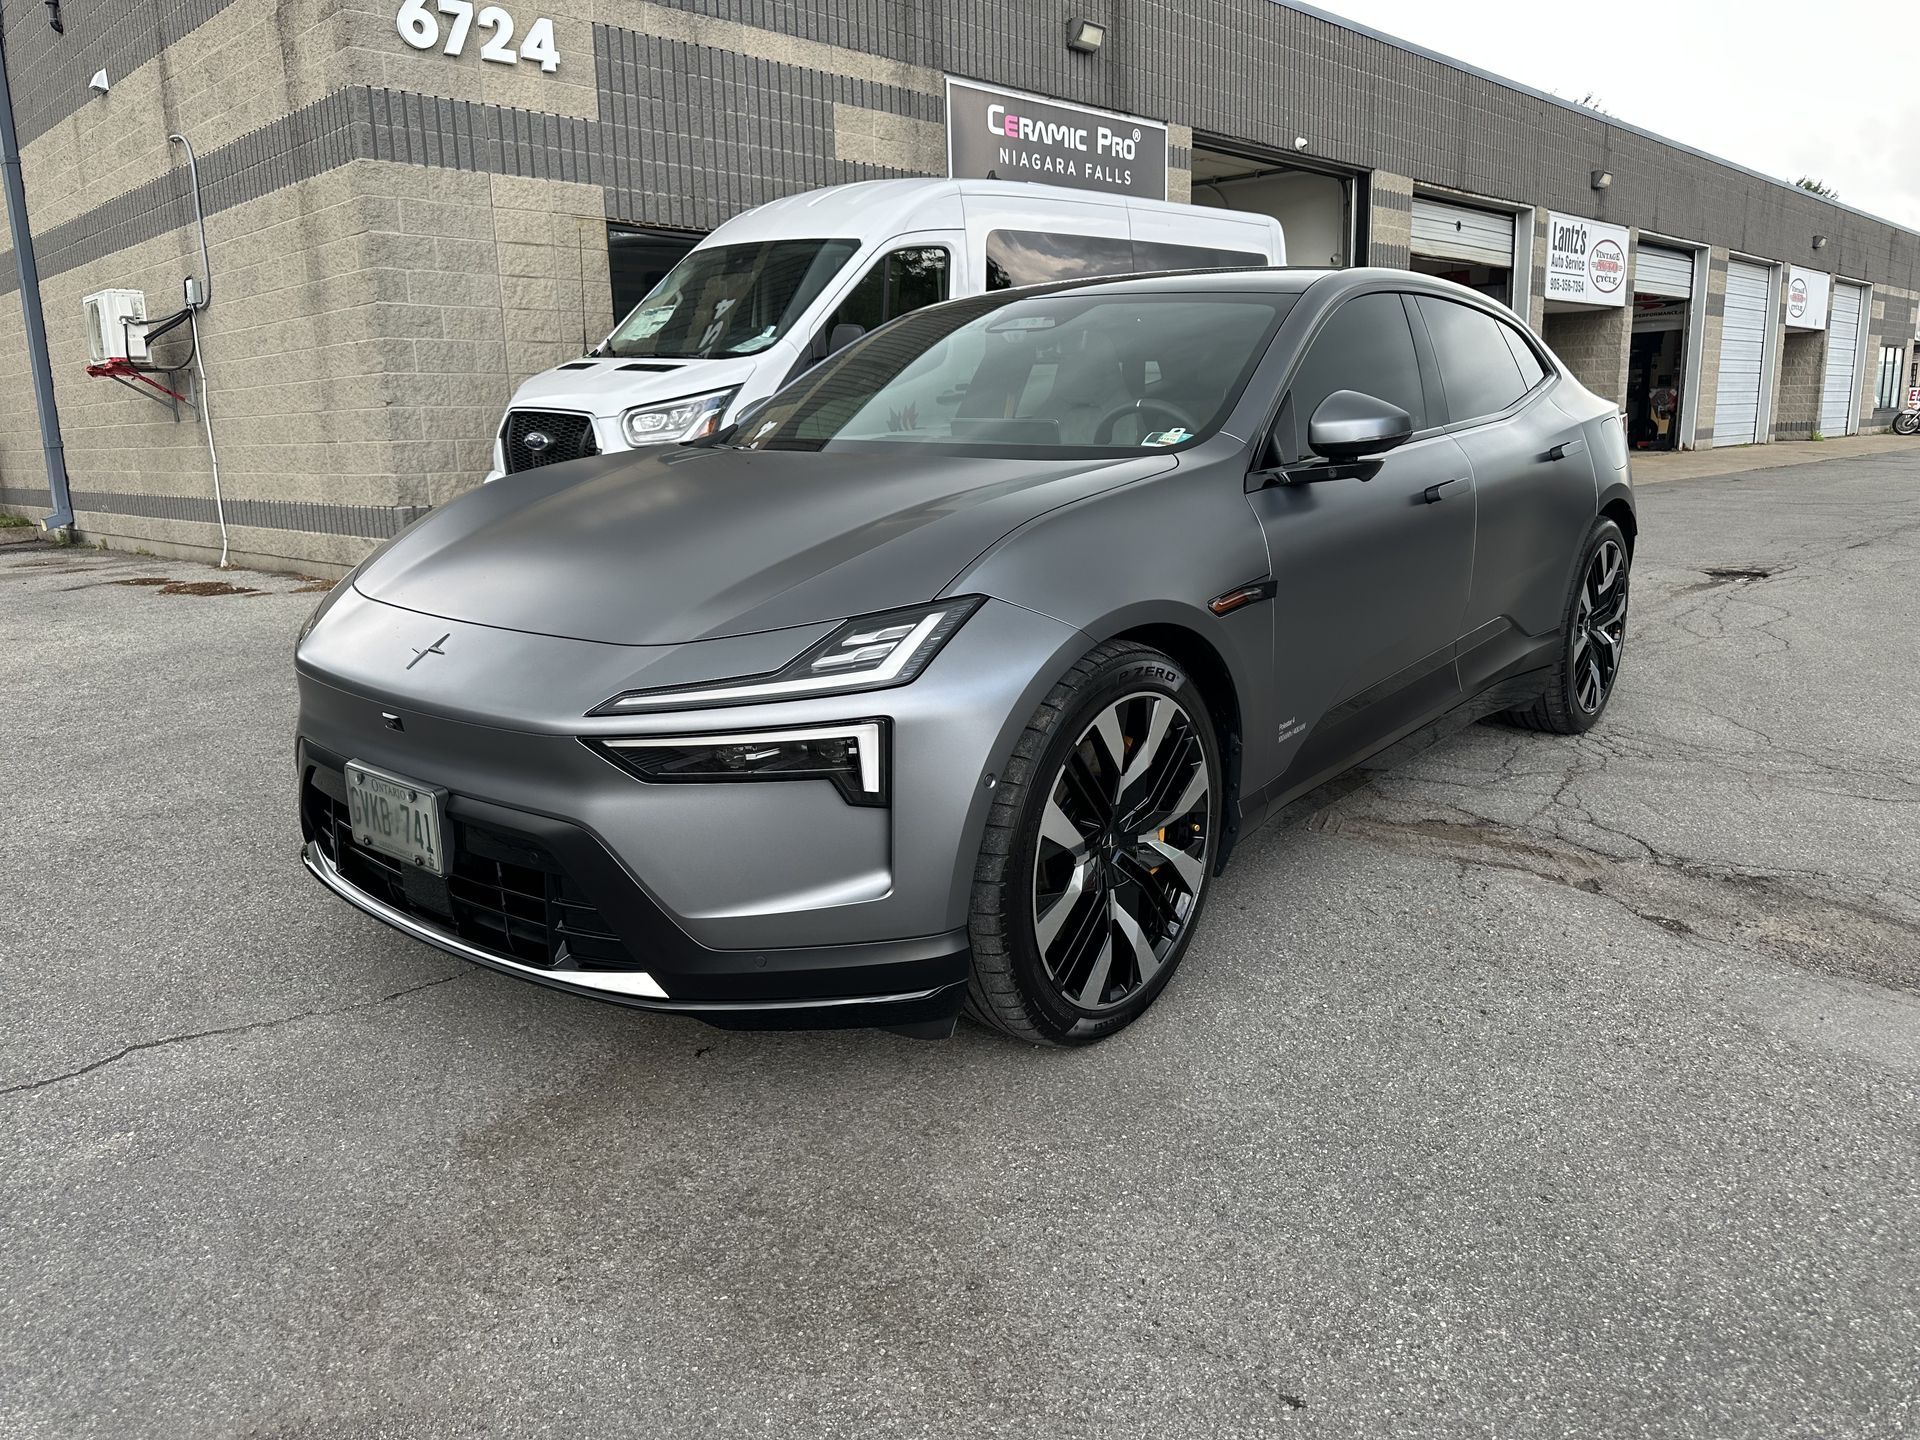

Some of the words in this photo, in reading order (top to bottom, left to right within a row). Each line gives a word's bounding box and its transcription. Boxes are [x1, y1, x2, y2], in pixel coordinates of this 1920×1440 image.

[396, 0, 561, 73] 6724
[999, 147, 1077, 176] NIAGARA
[1085, 162, 1132, 185] FALLS
[1552, 221, 1587, 255] Lantz's
[1551, 253, 1564, 268] Auto
[1565, 255, 1585, 272] Service
[1595, 275, 1618, 286] CYCLE
[1134, 666, 1176, 682] ZERO
